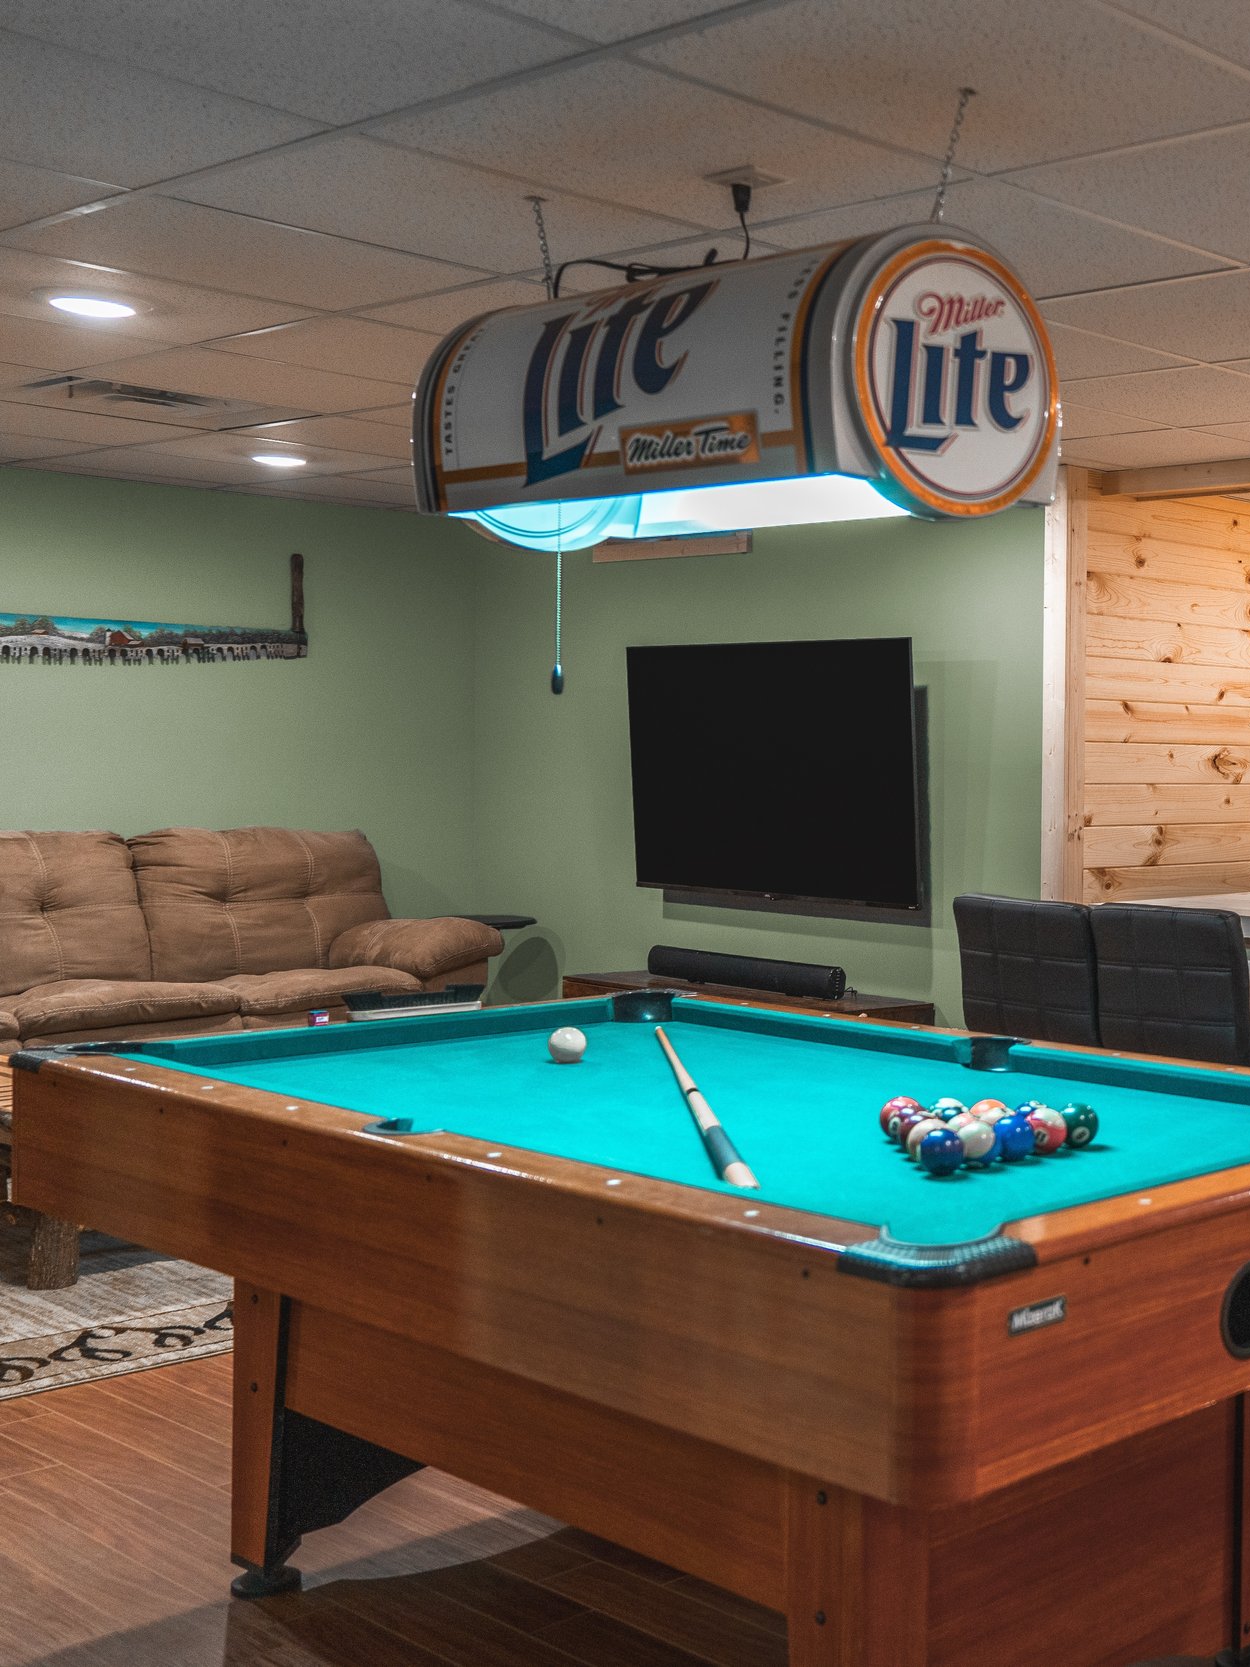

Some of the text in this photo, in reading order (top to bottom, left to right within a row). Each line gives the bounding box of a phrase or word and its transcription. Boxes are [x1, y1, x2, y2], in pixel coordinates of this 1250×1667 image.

[916, 291, 1005, 336] Miller
[522, 279, 720, 488] Lite
[884, 318, 1034, 454] Lite
[444, 384, 456, 456] TASTES
[628, 425, 749, 464] Miller Time
